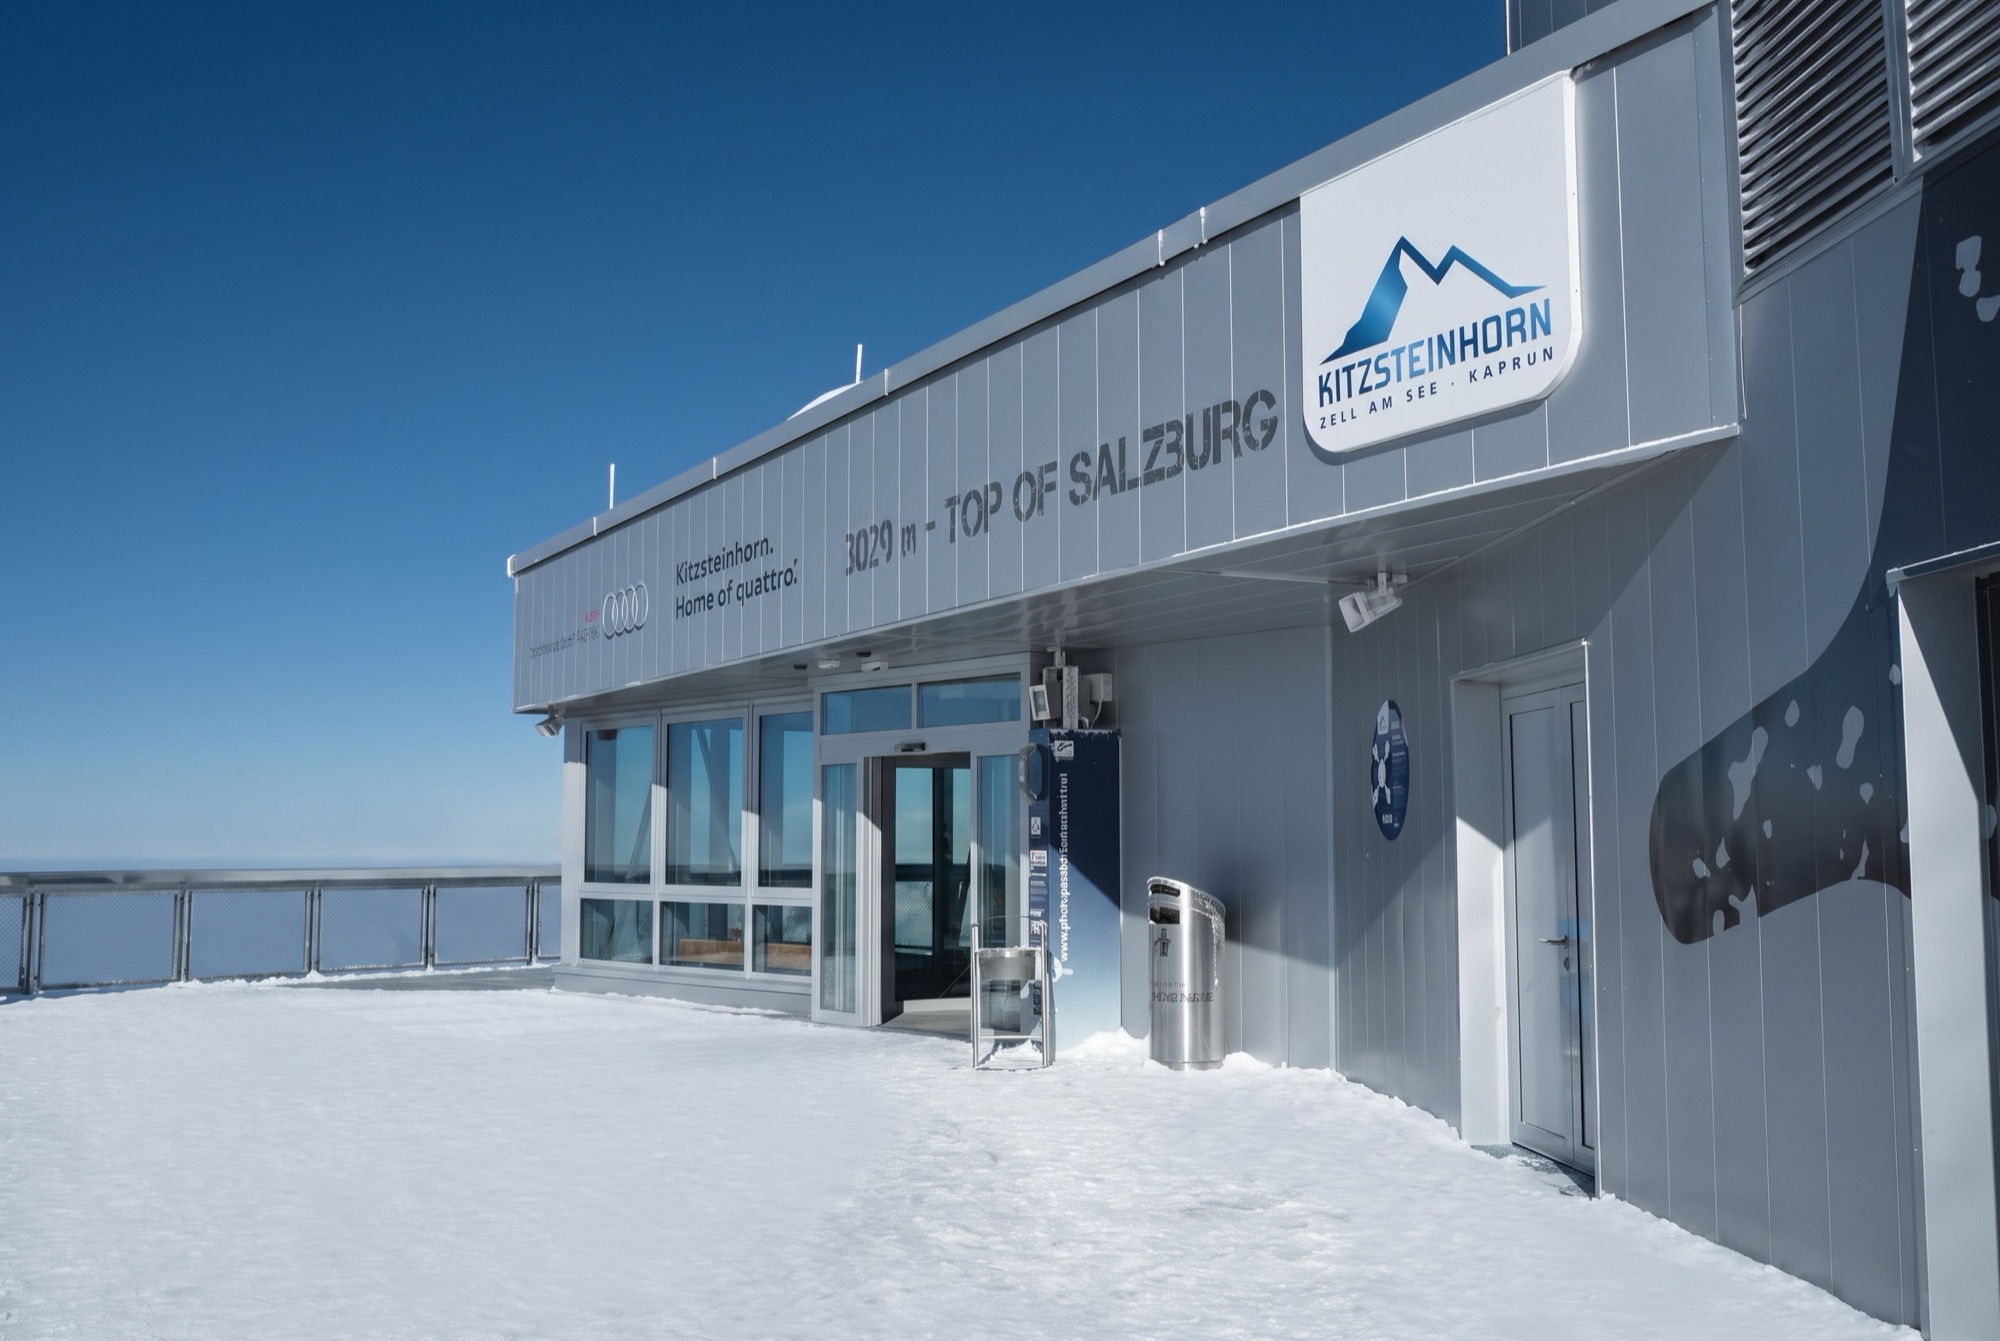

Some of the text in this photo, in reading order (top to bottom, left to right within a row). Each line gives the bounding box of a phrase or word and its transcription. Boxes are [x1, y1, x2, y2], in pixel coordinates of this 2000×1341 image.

[1318, 298, 1552, 408] KITZSTEINHORN
[1319, 407, 1357, 430] ZELL
[1369, 395, 1393, 415] AM
[1406, 381, 1438, 403] SEE
[1469, 346, 1554, 384] KAPRUN
[845, 519, 893, 576] 3029
[901, 522, 917, 557] m
[944, 482, 1002, 544] TOP
[1012, 460, 1058, 523] OF
[1068, 389, 1279, 506] SALZBURG
[676, 537, 774, 587] Kitzsteinhorn.
[676, 592, 714, 620] Home
[717, 579, 733, 607] of
